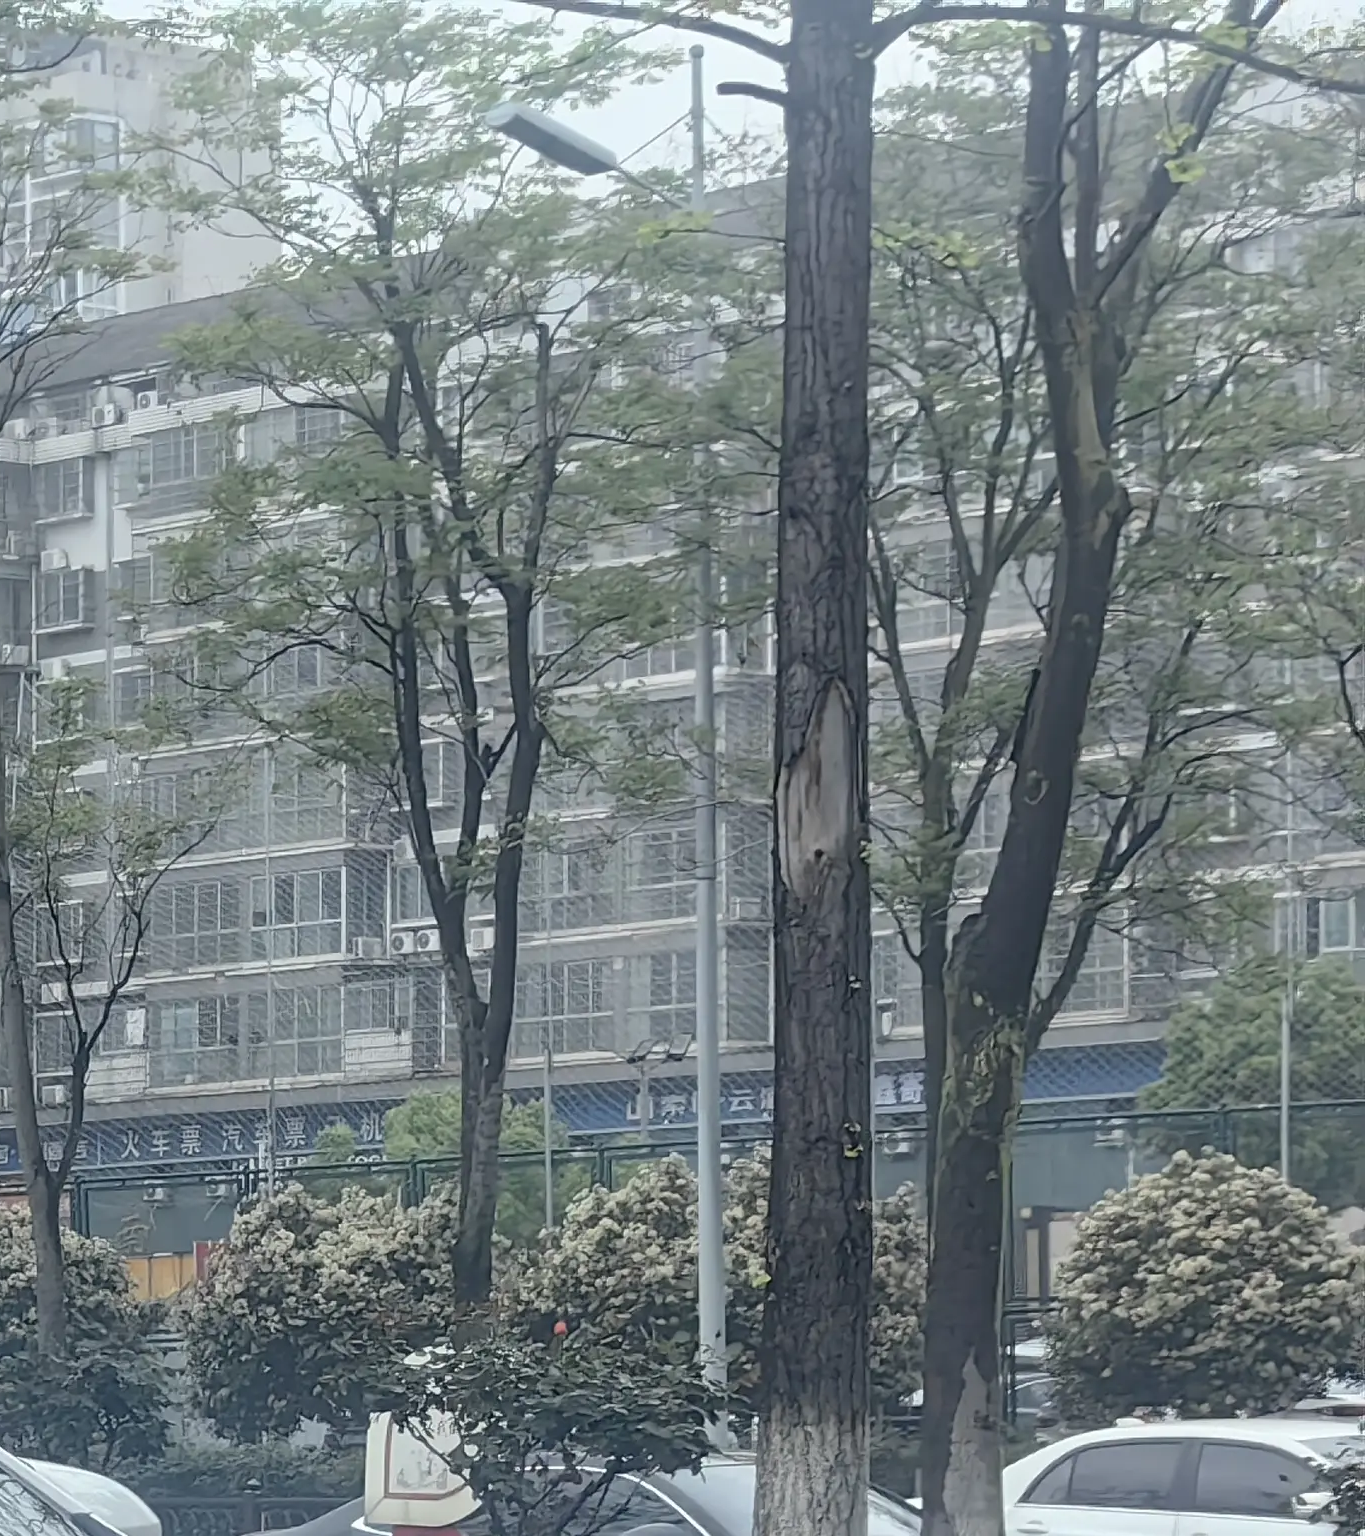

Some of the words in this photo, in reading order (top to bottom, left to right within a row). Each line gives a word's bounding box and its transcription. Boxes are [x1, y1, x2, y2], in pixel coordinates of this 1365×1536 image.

[120, 1124, 203, 1159] 火车票
[221, 1114, 307, 1152] 汽车票
